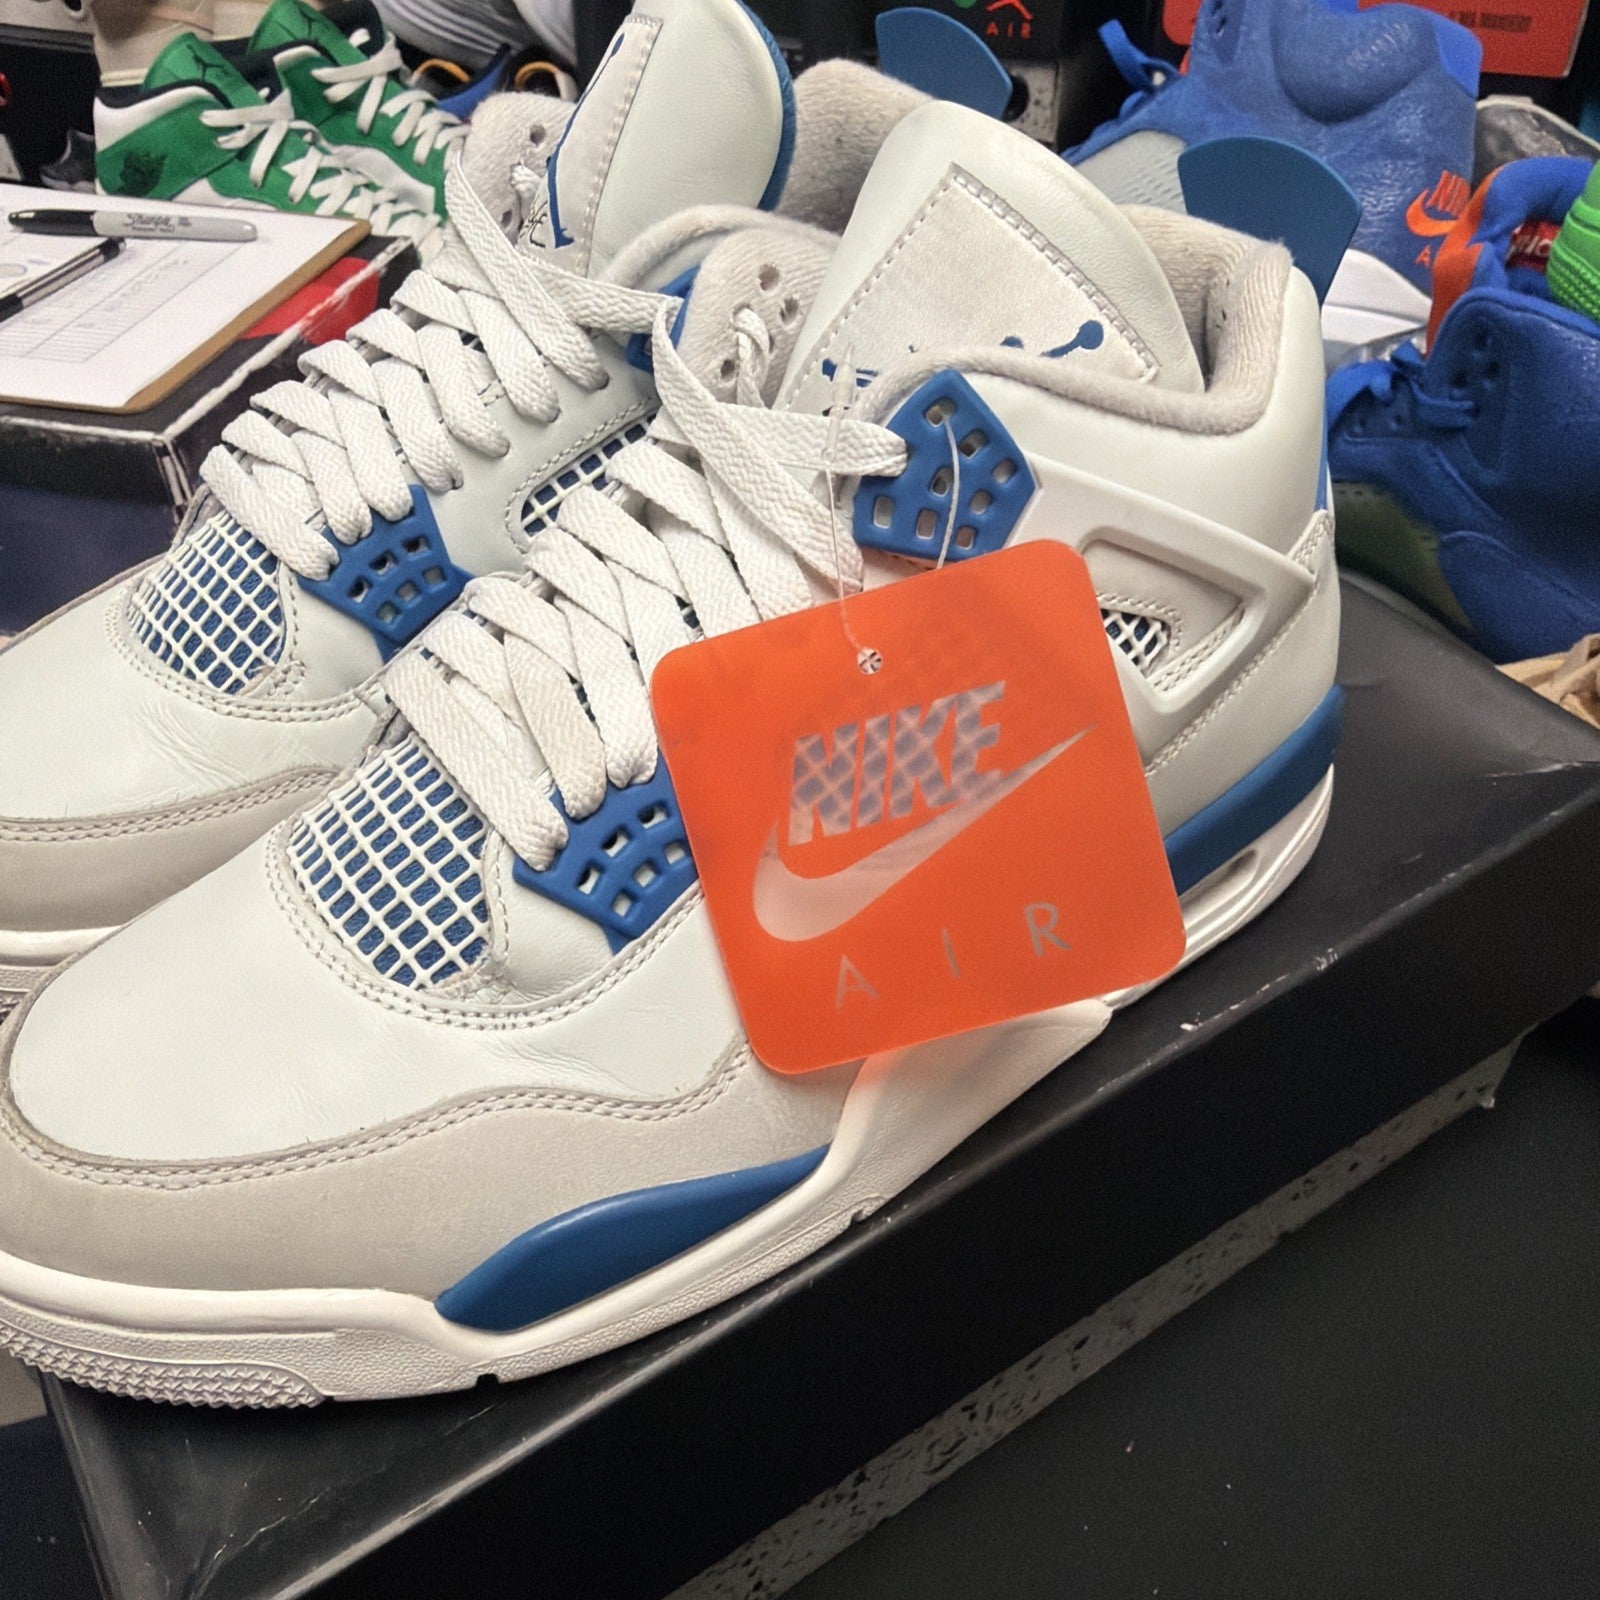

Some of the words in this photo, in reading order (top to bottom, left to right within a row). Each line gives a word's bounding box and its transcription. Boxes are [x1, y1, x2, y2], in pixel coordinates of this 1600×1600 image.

[985, 21, 1031, 39] AIR
[788, 680, 1006, 846] NIKE
[835, 902, 1071, 1011] AIR
